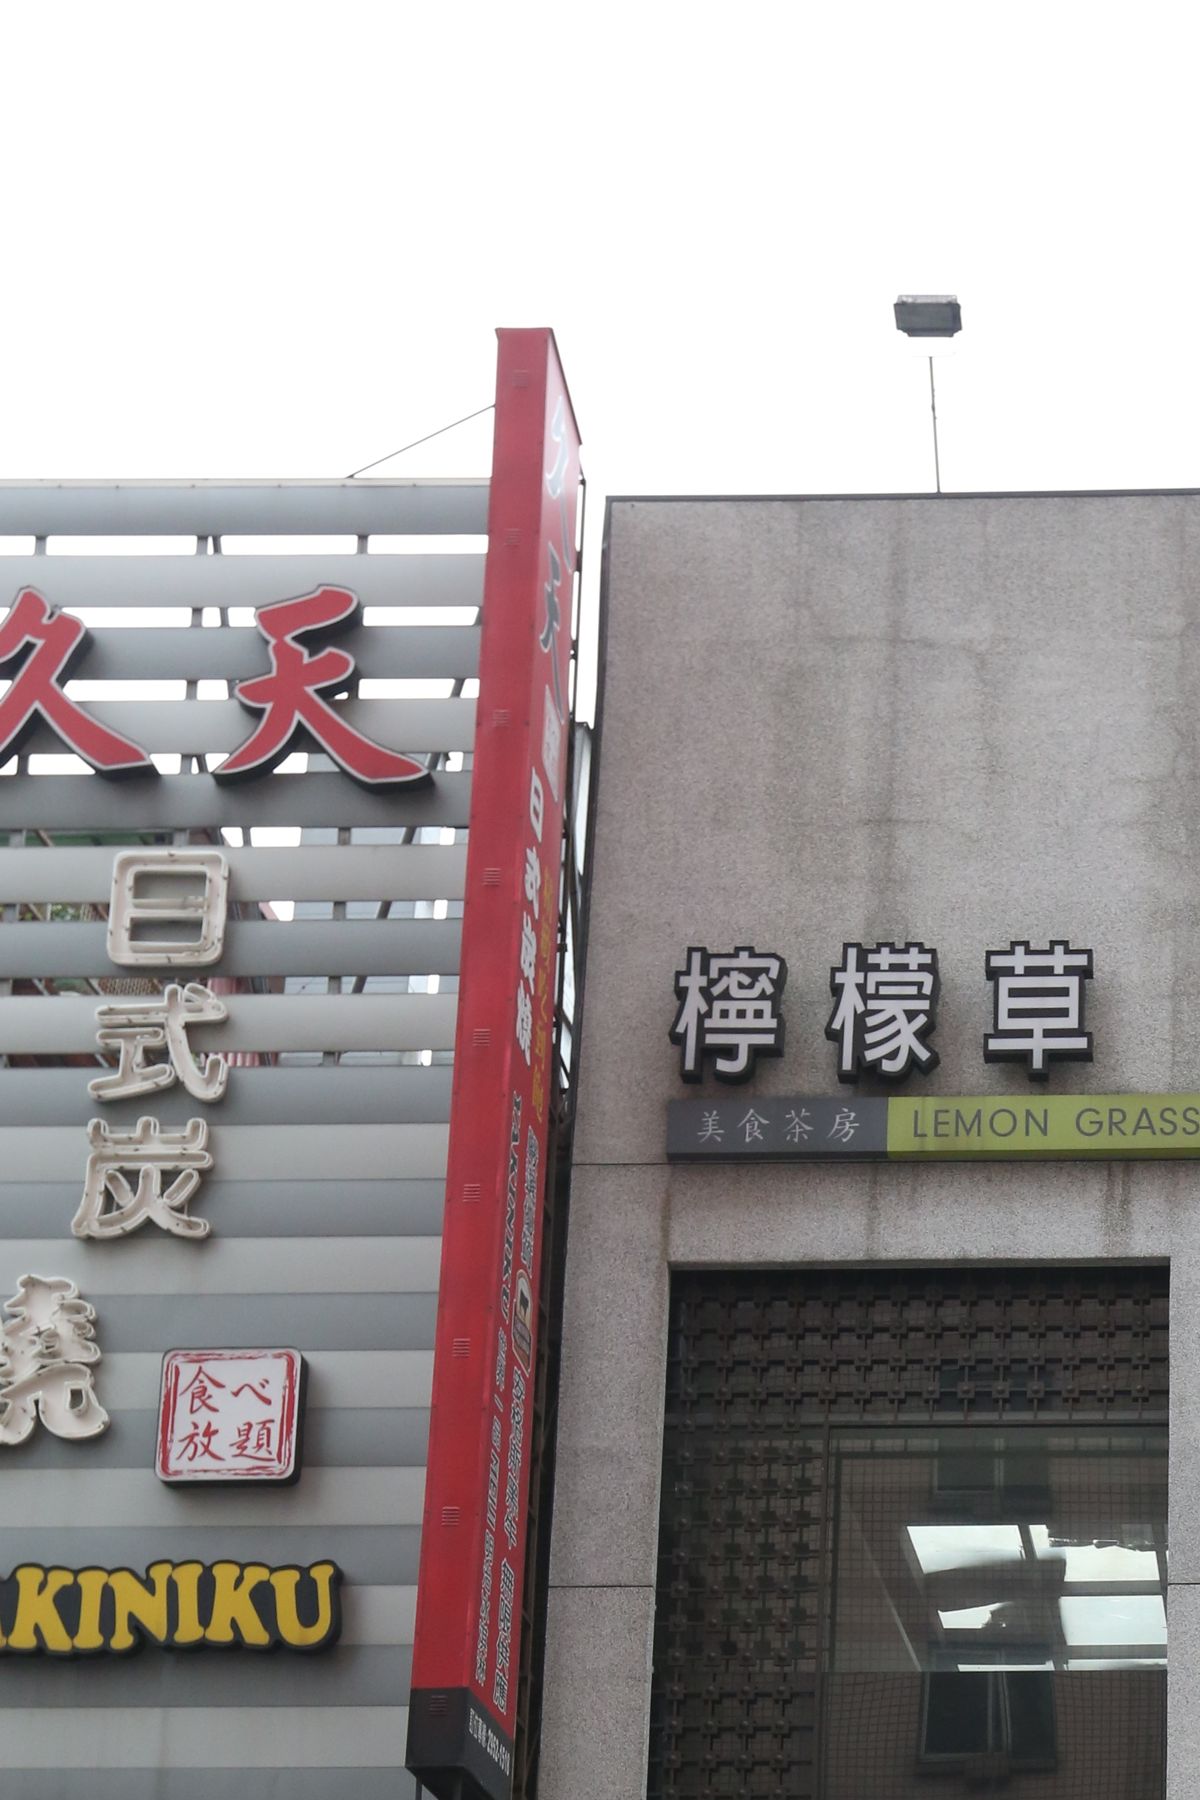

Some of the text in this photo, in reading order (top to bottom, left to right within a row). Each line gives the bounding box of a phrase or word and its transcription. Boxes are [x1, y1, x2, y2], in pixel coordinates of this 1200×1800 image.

[671, 942, 1092, 1082] 檸檬草
[696, 1106, 861, 1144] 美食茶房
[912, 1105, 1200, 1138] LEMON GRASS
[178, 1366, 272, 1415] 食べ
[175, 1419, 277, 1462] 放題
[0, 1561, 335, 1652] KINIKU
